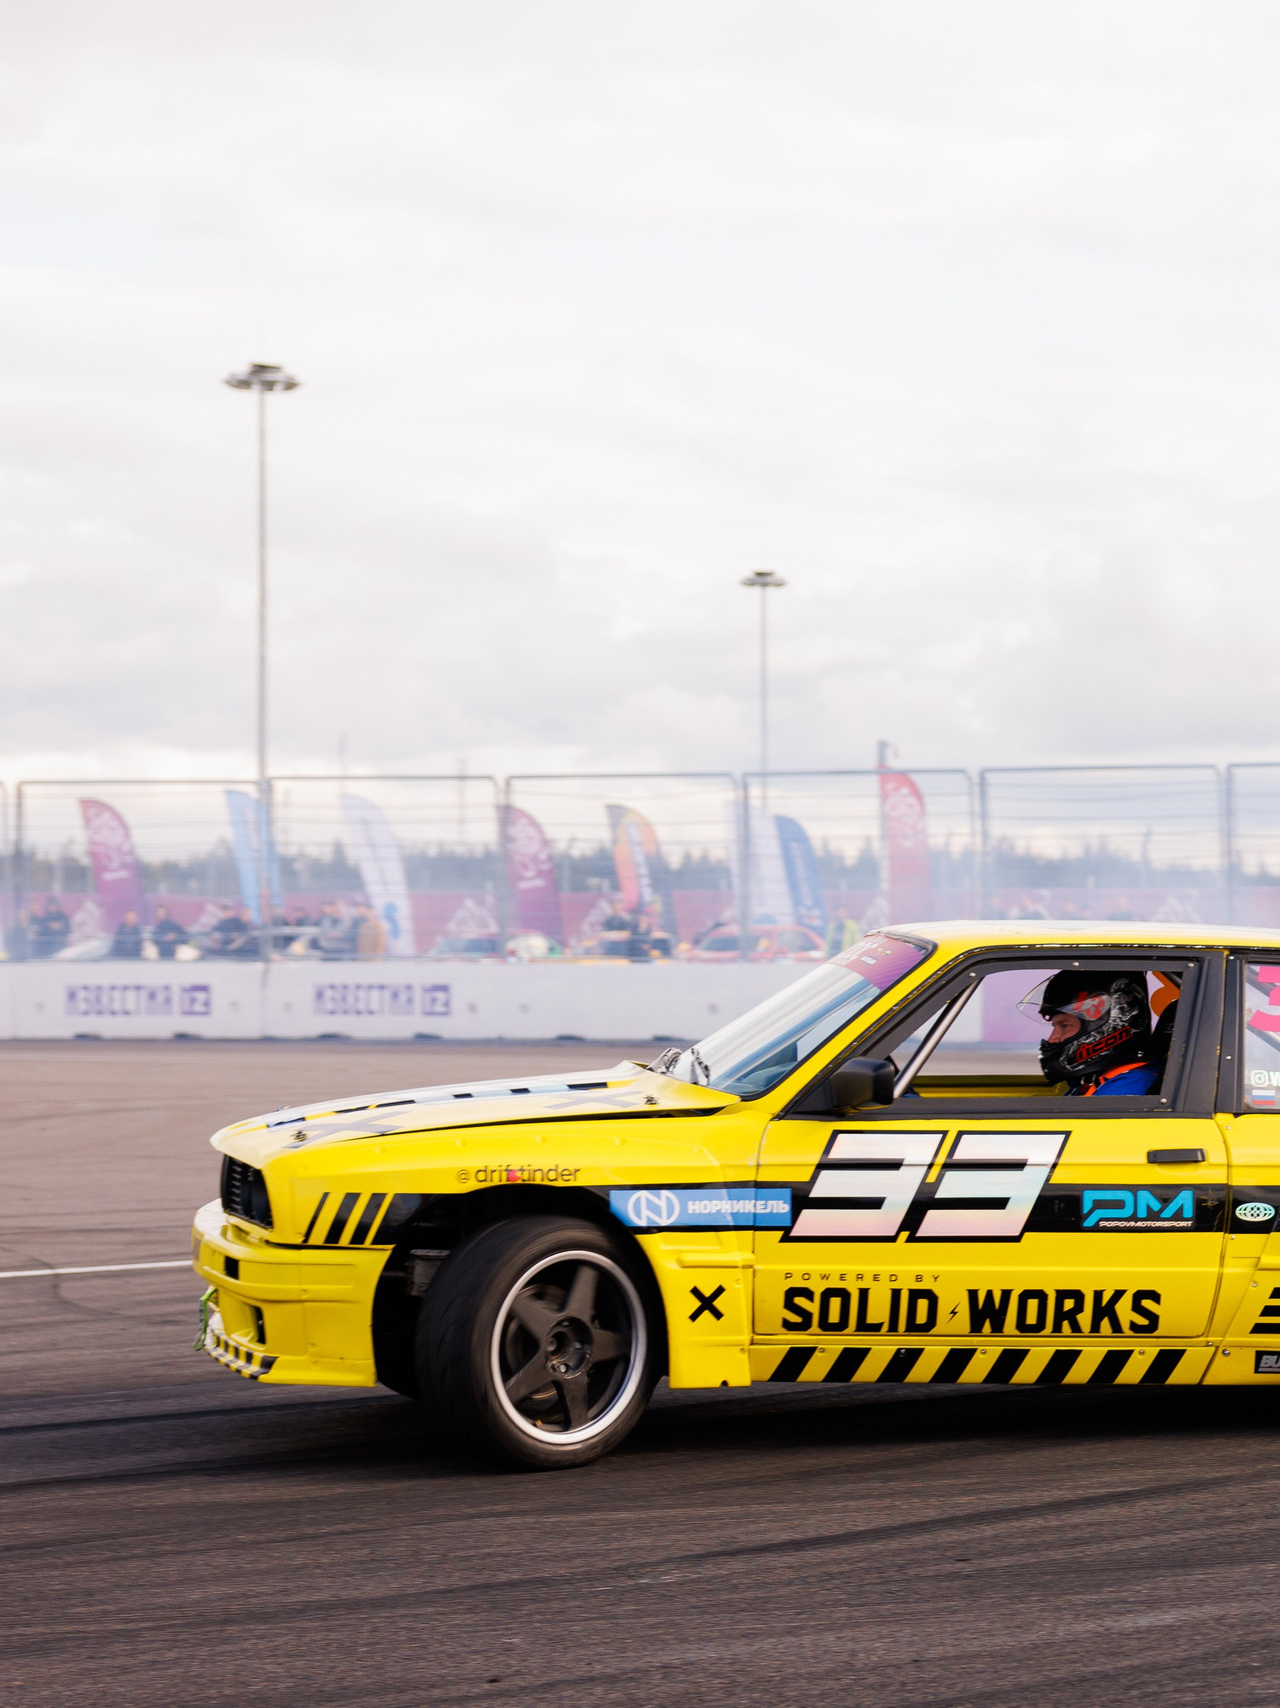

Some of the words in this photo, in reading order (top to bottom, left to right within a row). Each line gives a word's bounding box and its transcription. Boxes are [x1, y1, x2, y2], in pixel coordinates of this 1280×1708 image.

[785, 1132, 1069, 1240] 33
[687, 1200, 790, 1214] НОРНИКЕЛЬ
[1083, 1190, 1193, 1227] PM
[785, 1272, 898, 1283] POWERED
[915, 1274, 941, 1283] BY
[782, 1287, 939, 1332] SOLID
[966, 1289, 1161, 1334] WORKS
